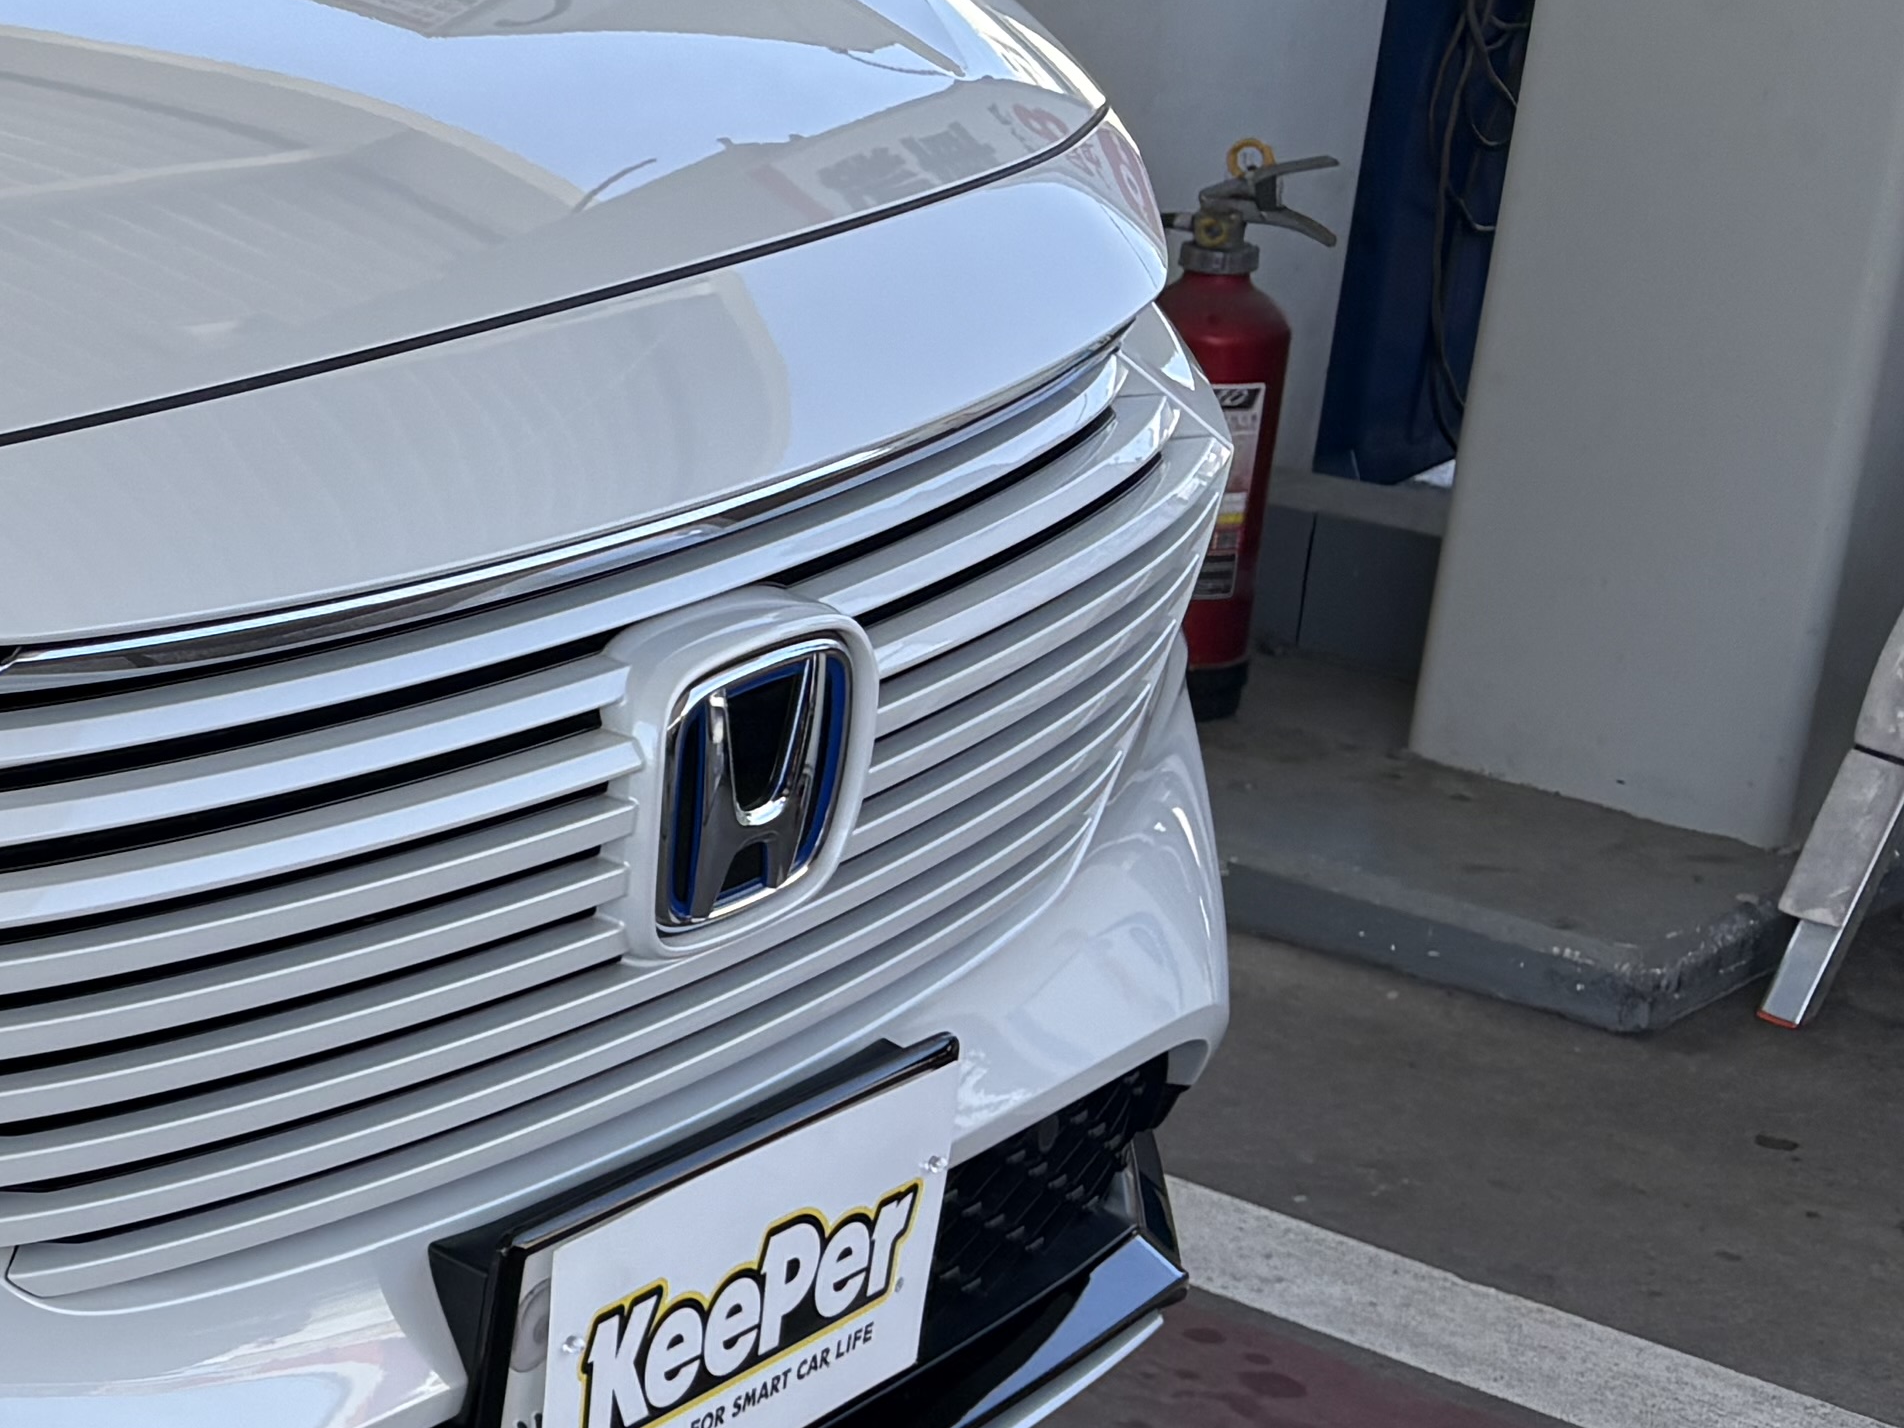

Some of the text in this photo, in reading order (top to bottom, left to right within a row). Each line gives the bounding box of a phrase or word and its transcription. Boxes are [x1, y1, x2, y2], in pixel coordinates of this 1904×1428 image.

[731, 1368, 790, 1419] SMART
[795, 1346, 831, 1382] CAR
[835, 1321, 875, 1361] LIFE
